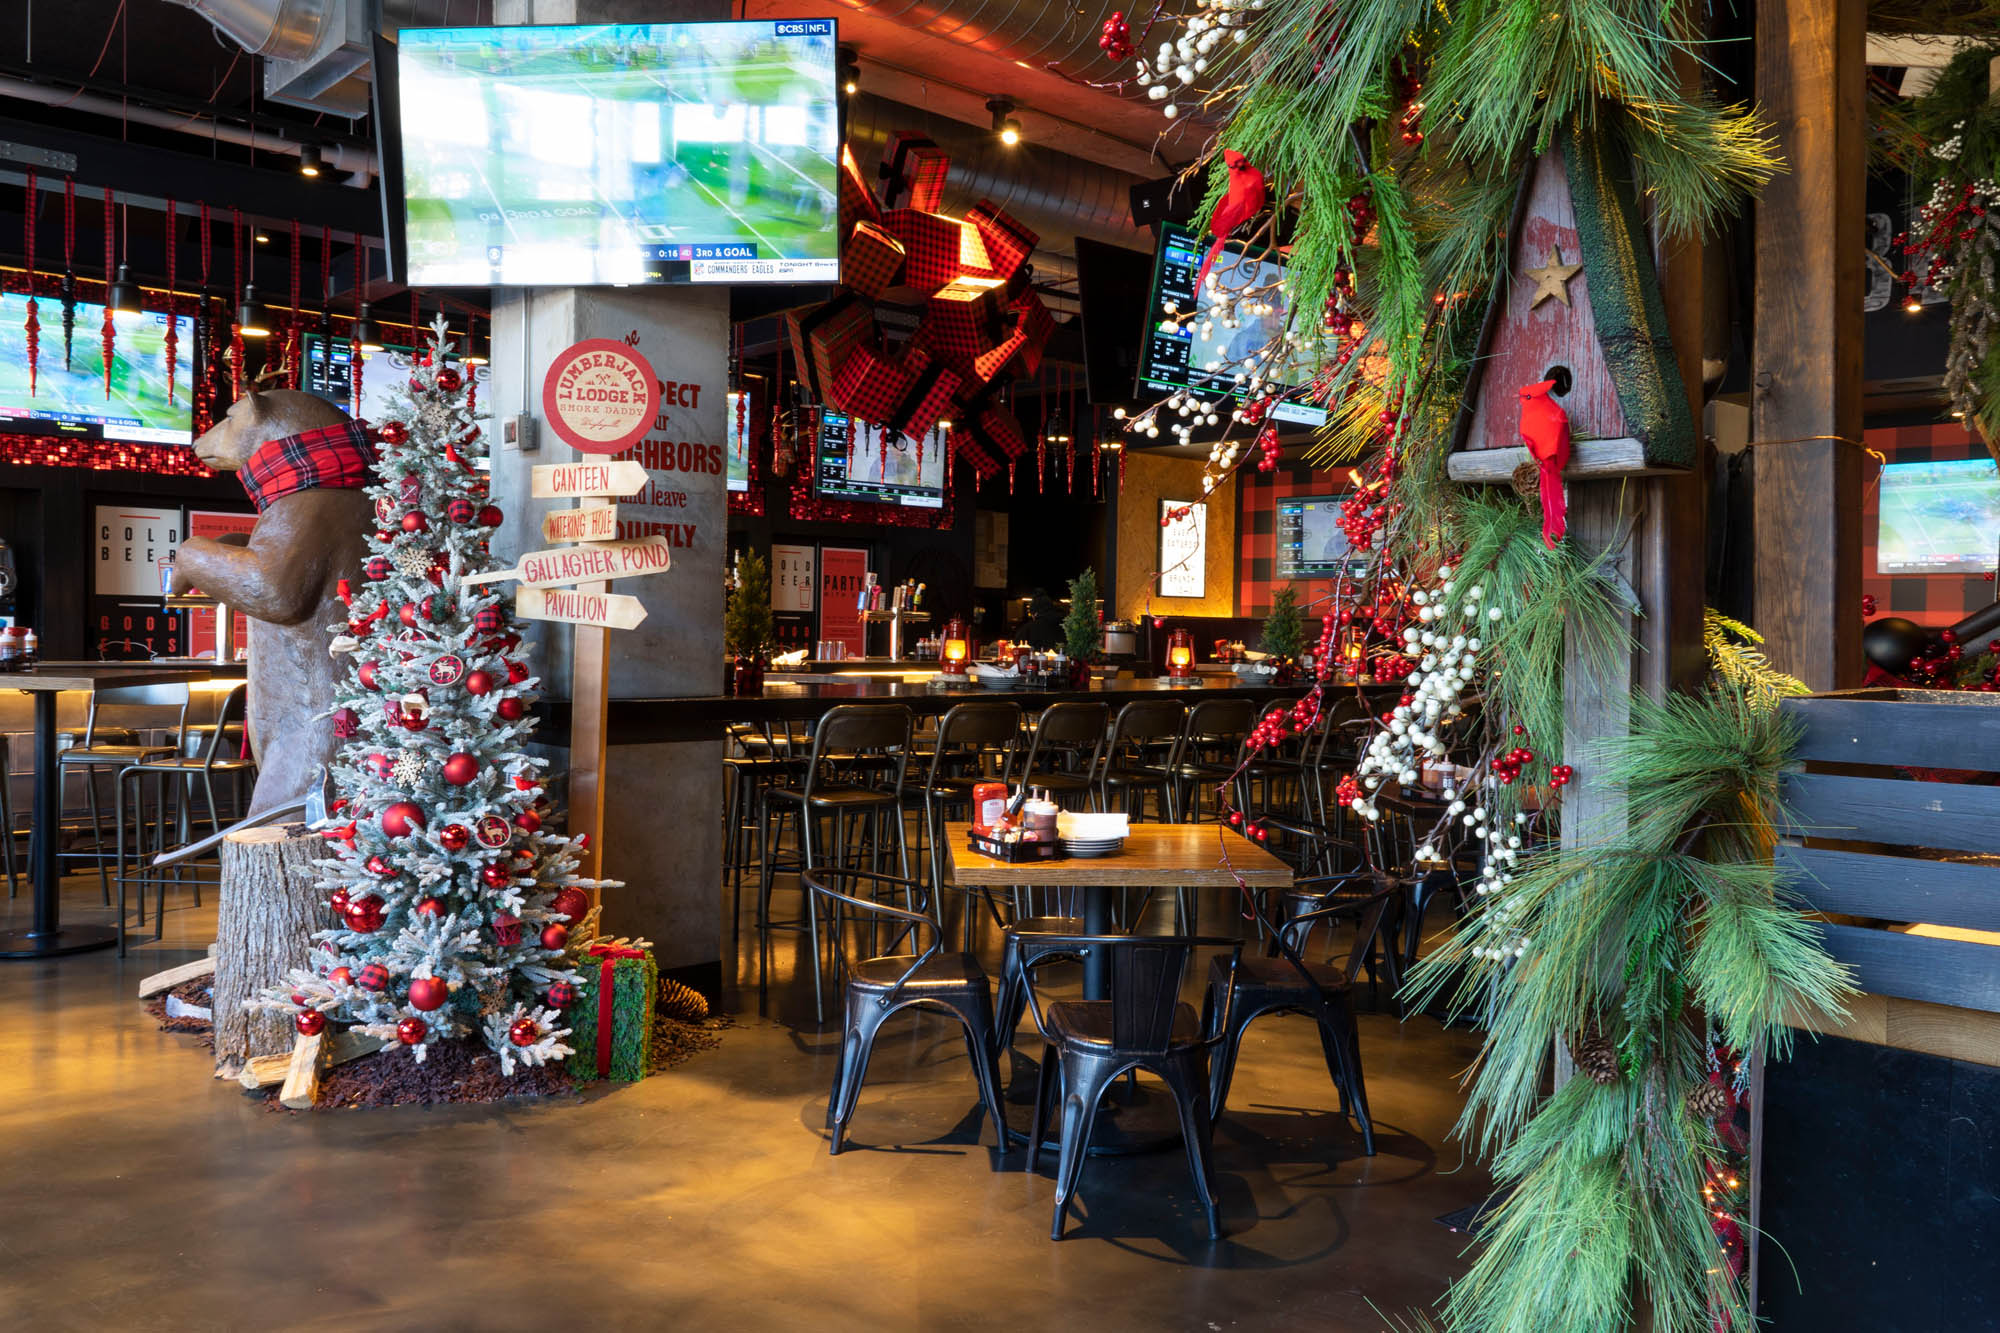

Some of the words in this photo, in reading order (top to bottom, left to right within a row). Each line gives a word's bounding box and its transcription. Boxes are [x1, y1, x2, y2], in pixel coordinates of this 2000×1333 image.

[785, 25, 804, 33] CBS
[809, 24, 829, 33] NFL
[696, 248, 713, 257] 3RD
[715, 248, 722, 257] &
[723, 247, 753, 257] GOAL
[707, 264, 748, 274] COMMANDERS
[752, 264, 775, 274] EAGLES
[559, 354, 647, 405] LUMBERJACK
[576, 388, 629, 403] LODGE
[658, 380, 702, 409] PECT
[560, 403, 600, 413] SMOKE
[605, 405, 645, 416] DADDY
[617, 440, 722, 475] GHBORS
[552, 466, 610, 493] CANTEEN
[651, 480, 688, 508] leave
[102, 526, 176, 543] COLD
[549, 513, 587, 540] WATERING
[591, 509, 613, 535] HOLE
[101, 546, 176, 563] BEER
[524, 550, 618, 584] GALLAGHER
[621, 543, 670, 572] POND
[824, 575, 864, 592] PARTY
[544, 591, 608, 622] PAVILLION
